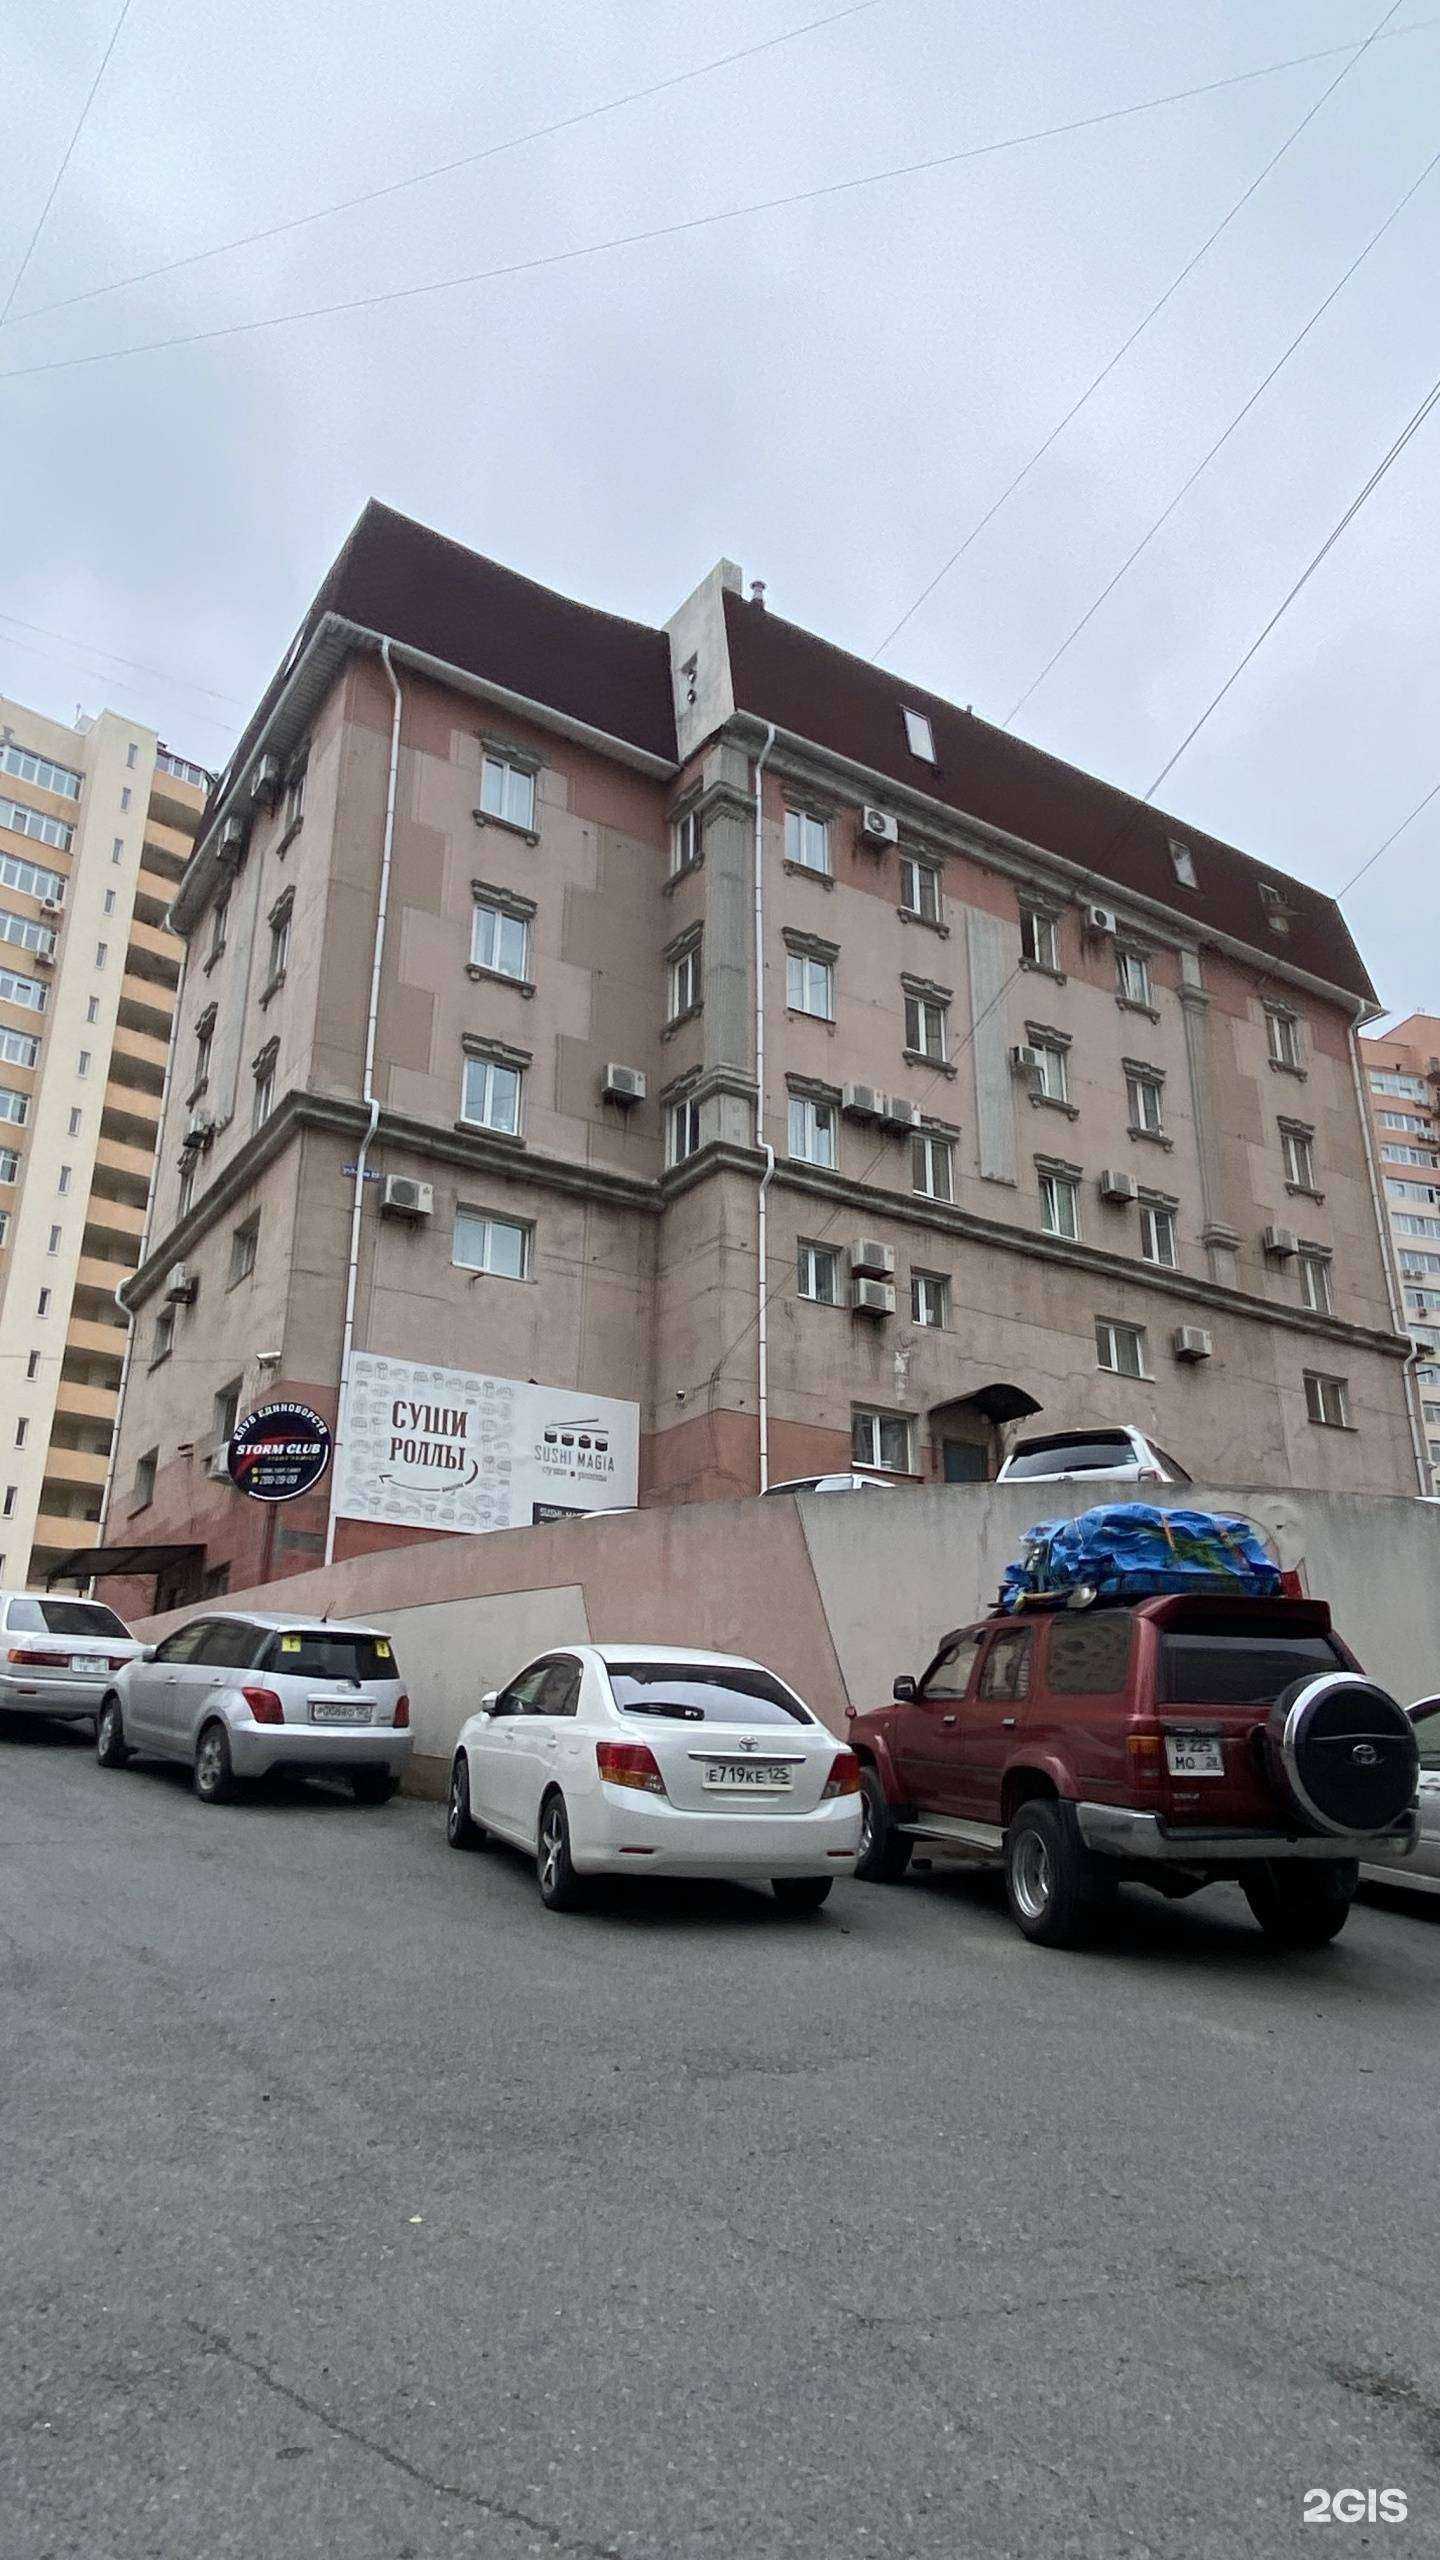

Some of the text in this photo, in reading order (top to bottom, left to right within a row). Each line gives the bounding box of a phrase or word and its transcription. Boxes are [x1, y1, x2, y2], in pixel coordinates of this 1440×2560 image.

[392, 1400, 468, 1438] СУШИ
[236, 1444, 321, 1455] STORM CLUB
[389, 1437, 466, 1471] РОЛЛЫ
[534, 1445, 615, 1472] SUSHI MAGIA
[768, 1767, 790, 1780] 125
